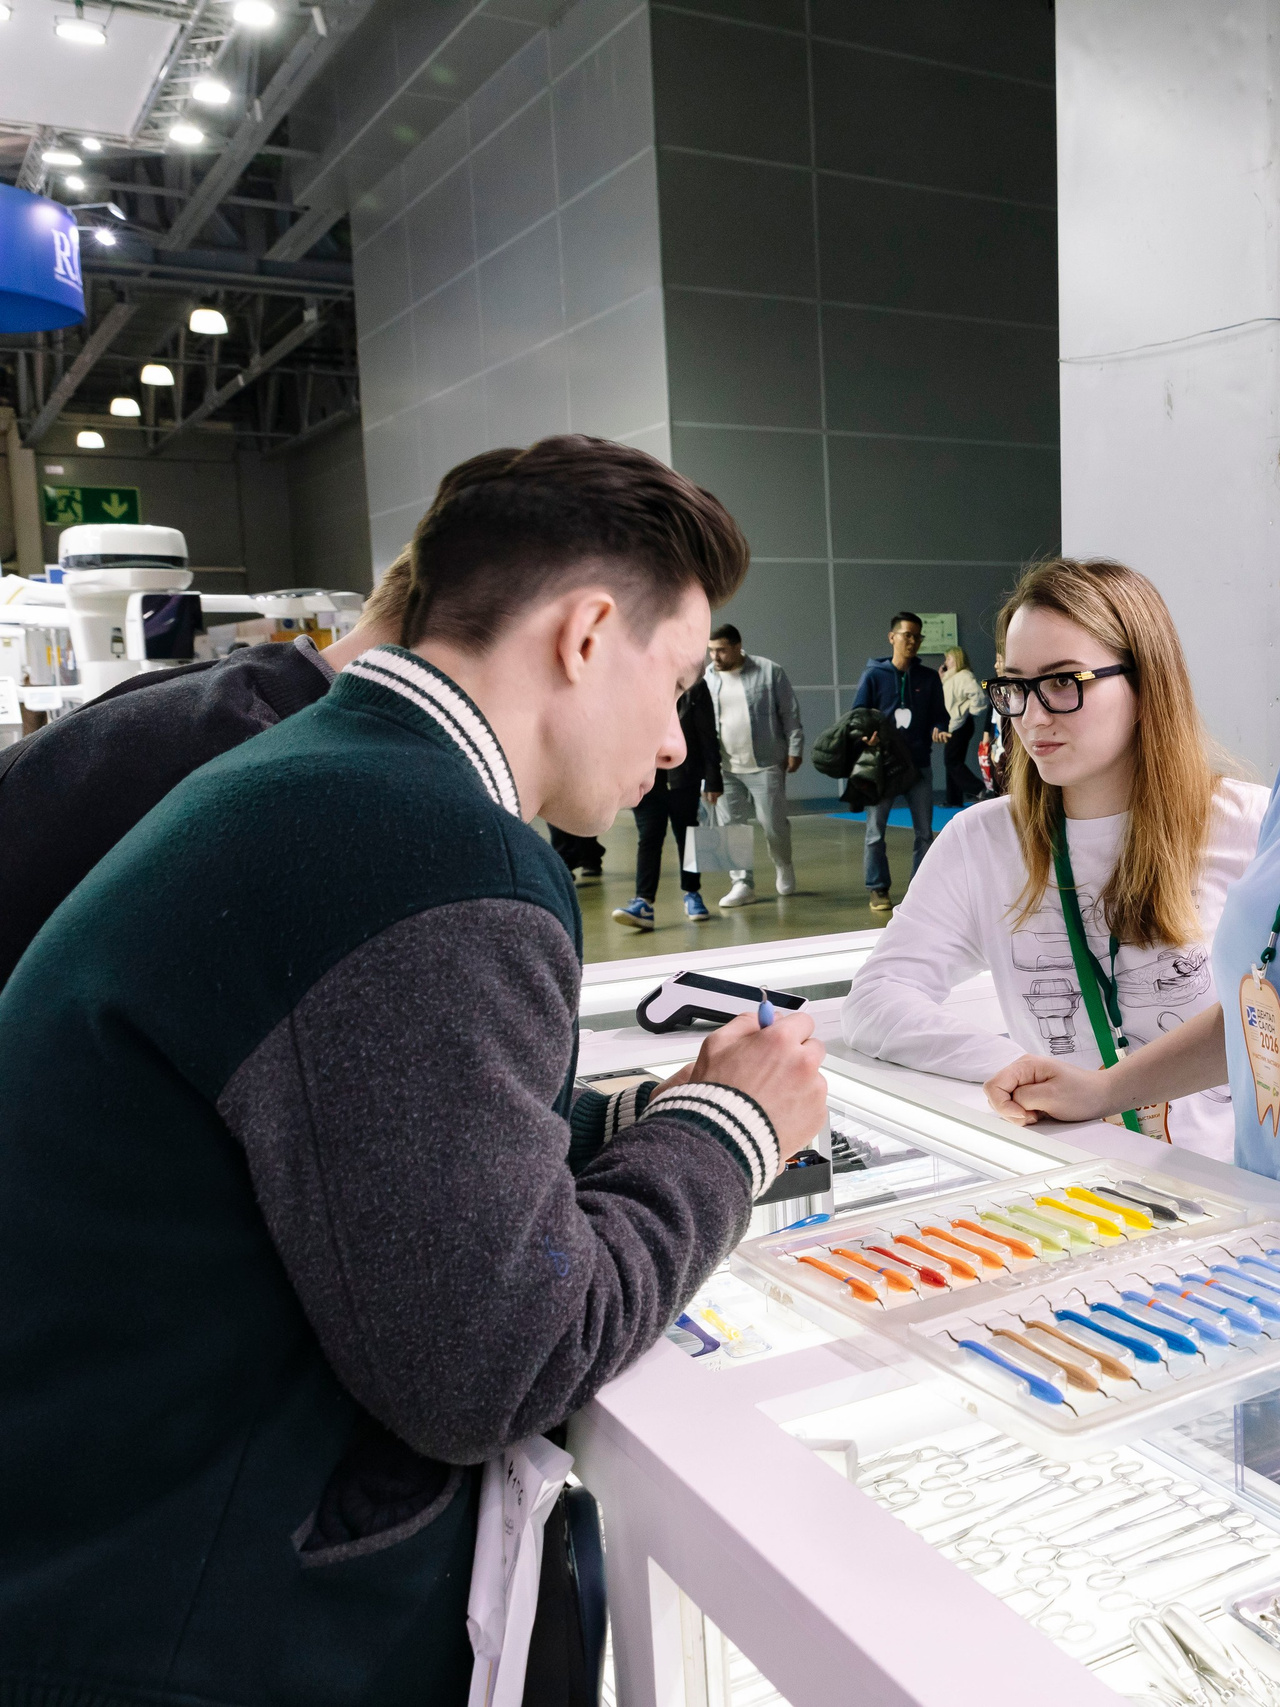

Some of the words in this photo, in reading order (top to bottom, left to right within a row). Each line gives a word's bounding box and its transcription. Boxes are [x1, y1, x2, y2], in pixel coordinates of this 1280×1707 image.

[1257, 1009, 1275, 1023] ДЕНТАЛ
[1258, 1020, 1275, 1034] САЛОН
[1260, 1031, 1279, 1055] 2026
